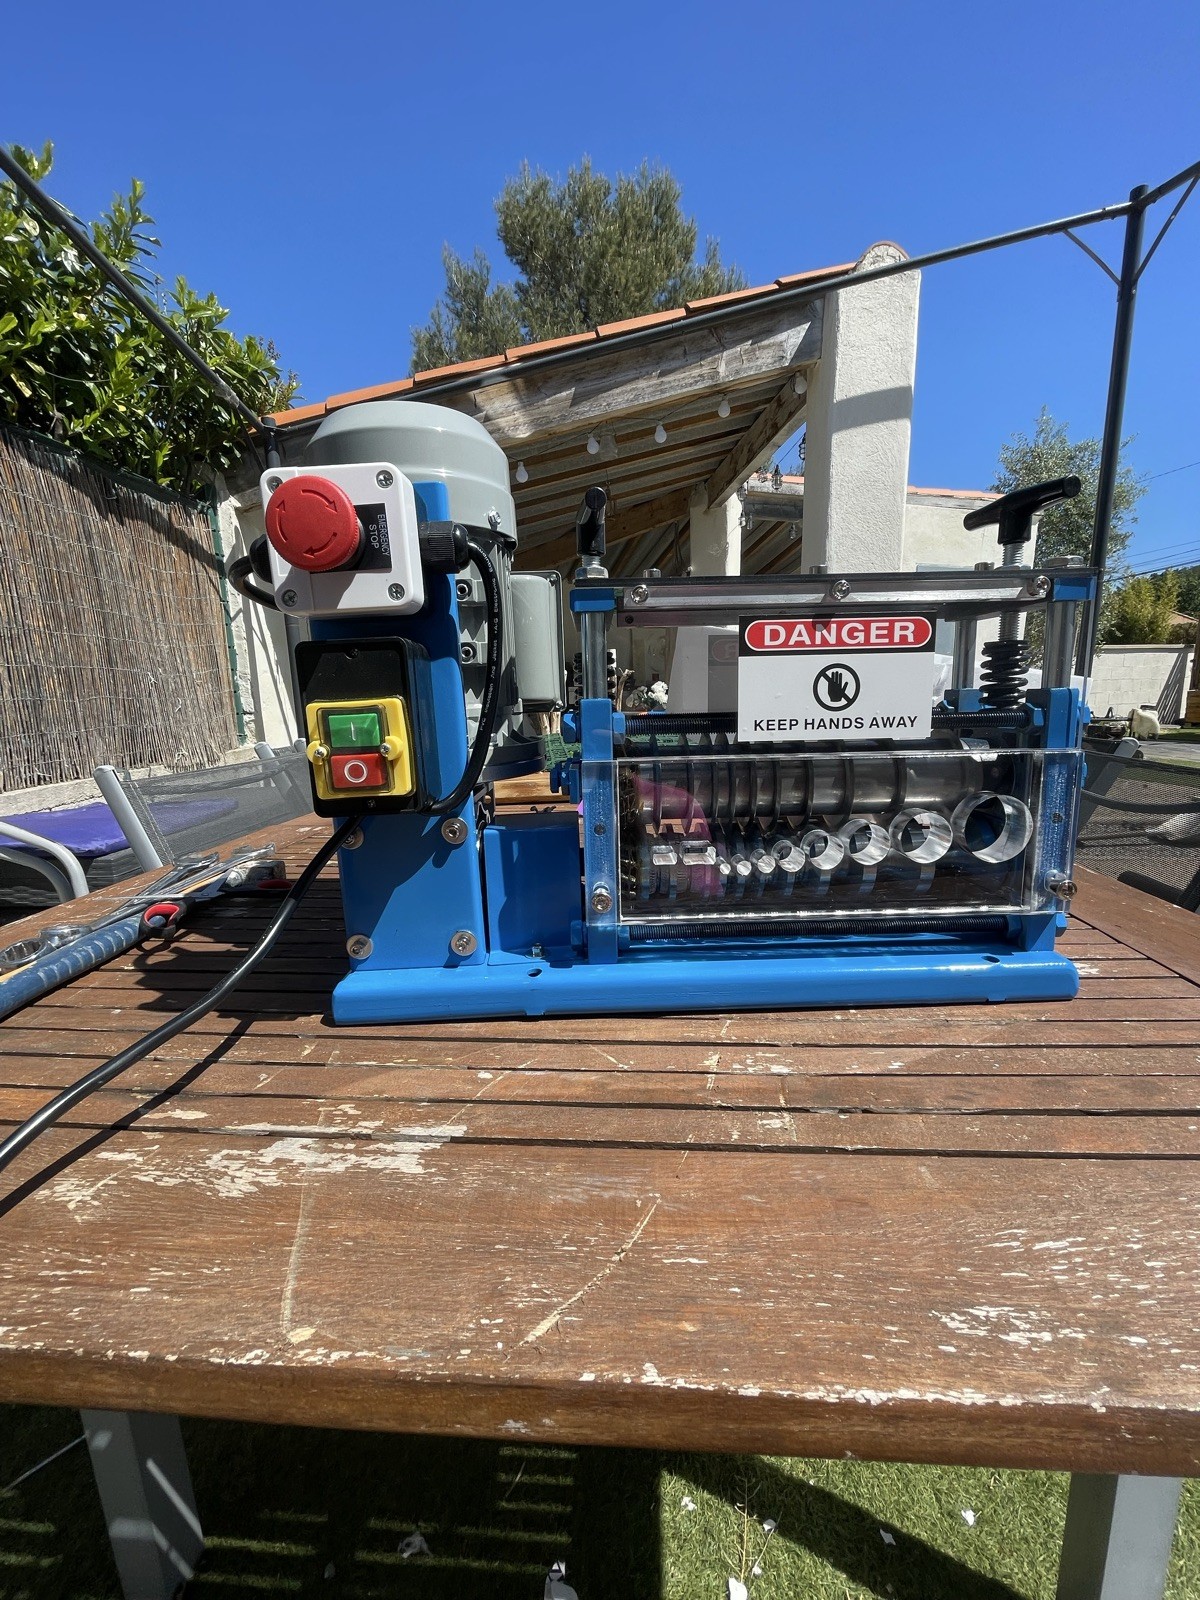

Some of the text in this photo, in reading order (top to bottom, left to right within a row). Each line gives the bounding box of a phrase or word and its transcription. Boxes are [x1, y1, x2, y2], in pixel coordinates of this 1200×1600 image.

[369, 524, 379, 549] STOP
[377, 514, 390, 556] EMERGENCY
[763, 621, 916, 646] DANGER
[754, 716, 918, 731] KEEP HANDS AWAY
